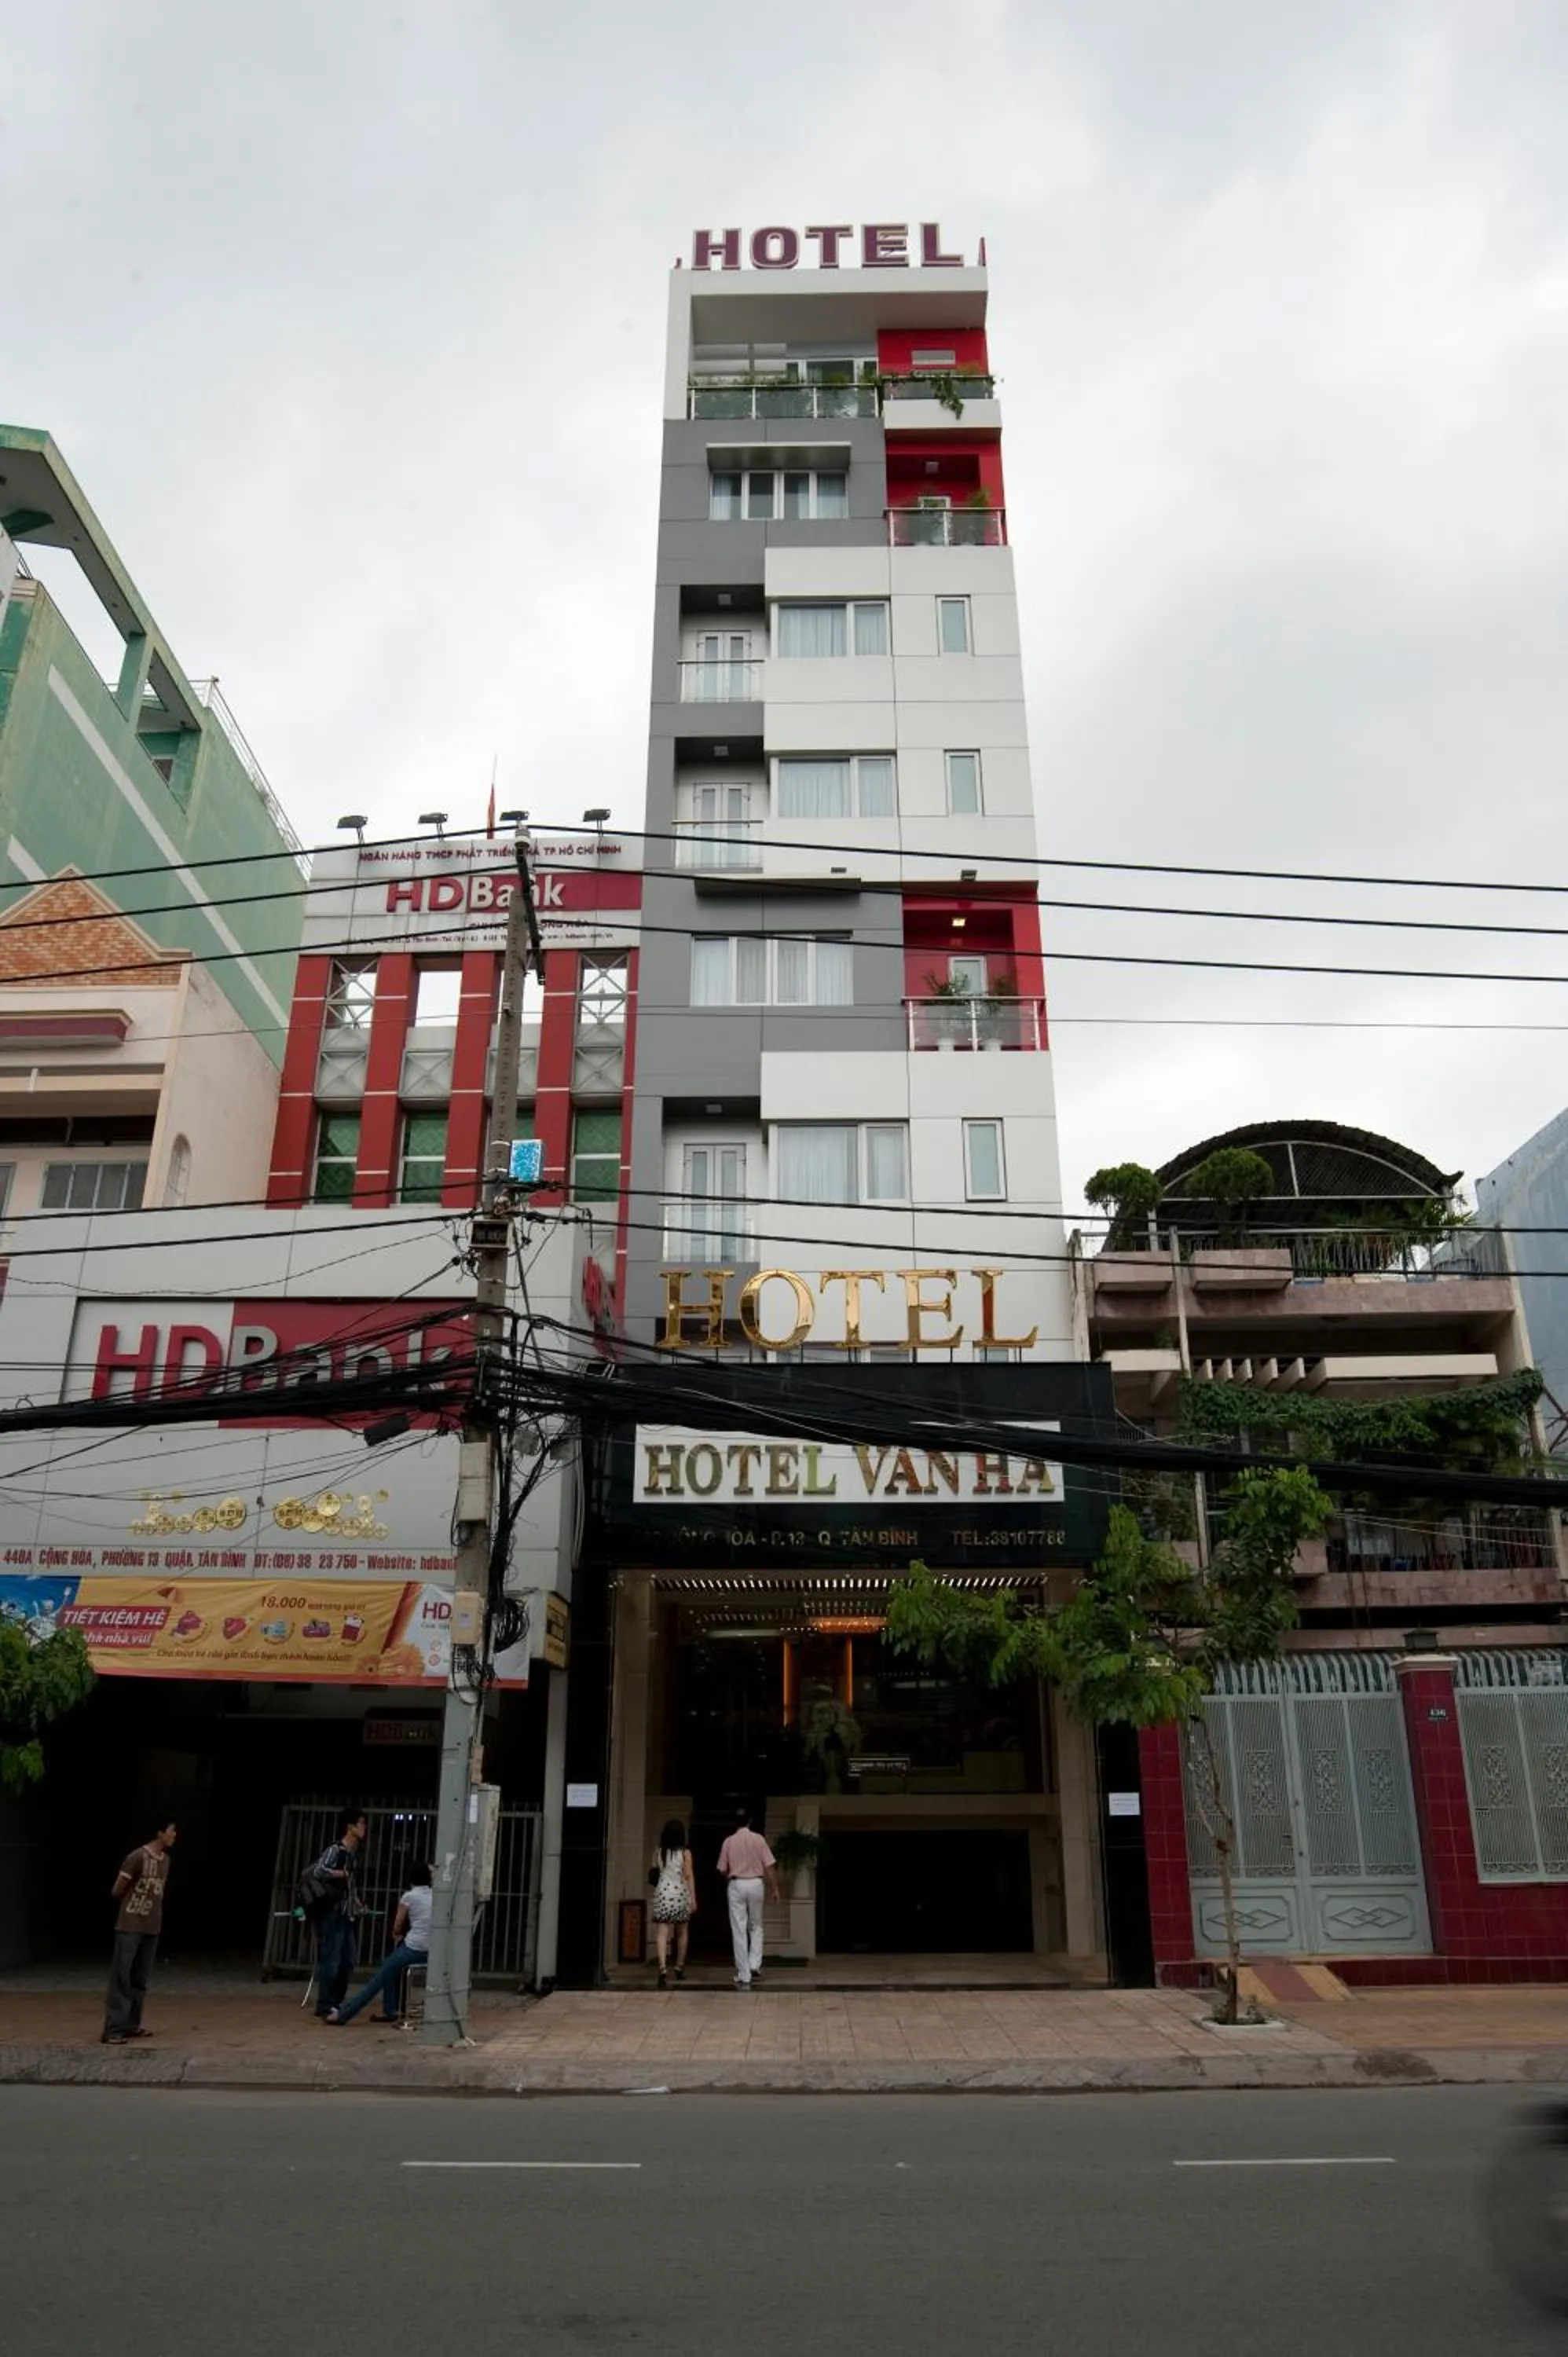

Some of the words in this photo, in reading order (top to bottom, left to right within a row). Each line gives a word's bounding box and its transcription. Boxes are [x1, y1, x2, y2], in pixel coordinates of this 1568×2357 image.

[691, 223, 964, 270] HOTEL
[654, 1269, 1039, 1351] HOTEL
[643, 1443, 837, 1497] HOTEL
[419, 1556, 457, 1571] hdban
[262, 1596, 306, 1608] 18.000
[422, 1601, 453, 1620] HD
[63, 1607, 98, 1625] TIẾT
[99, 1608, 141, 1628] KIỆM
[142, 1608, 167, 1625] HÈ
